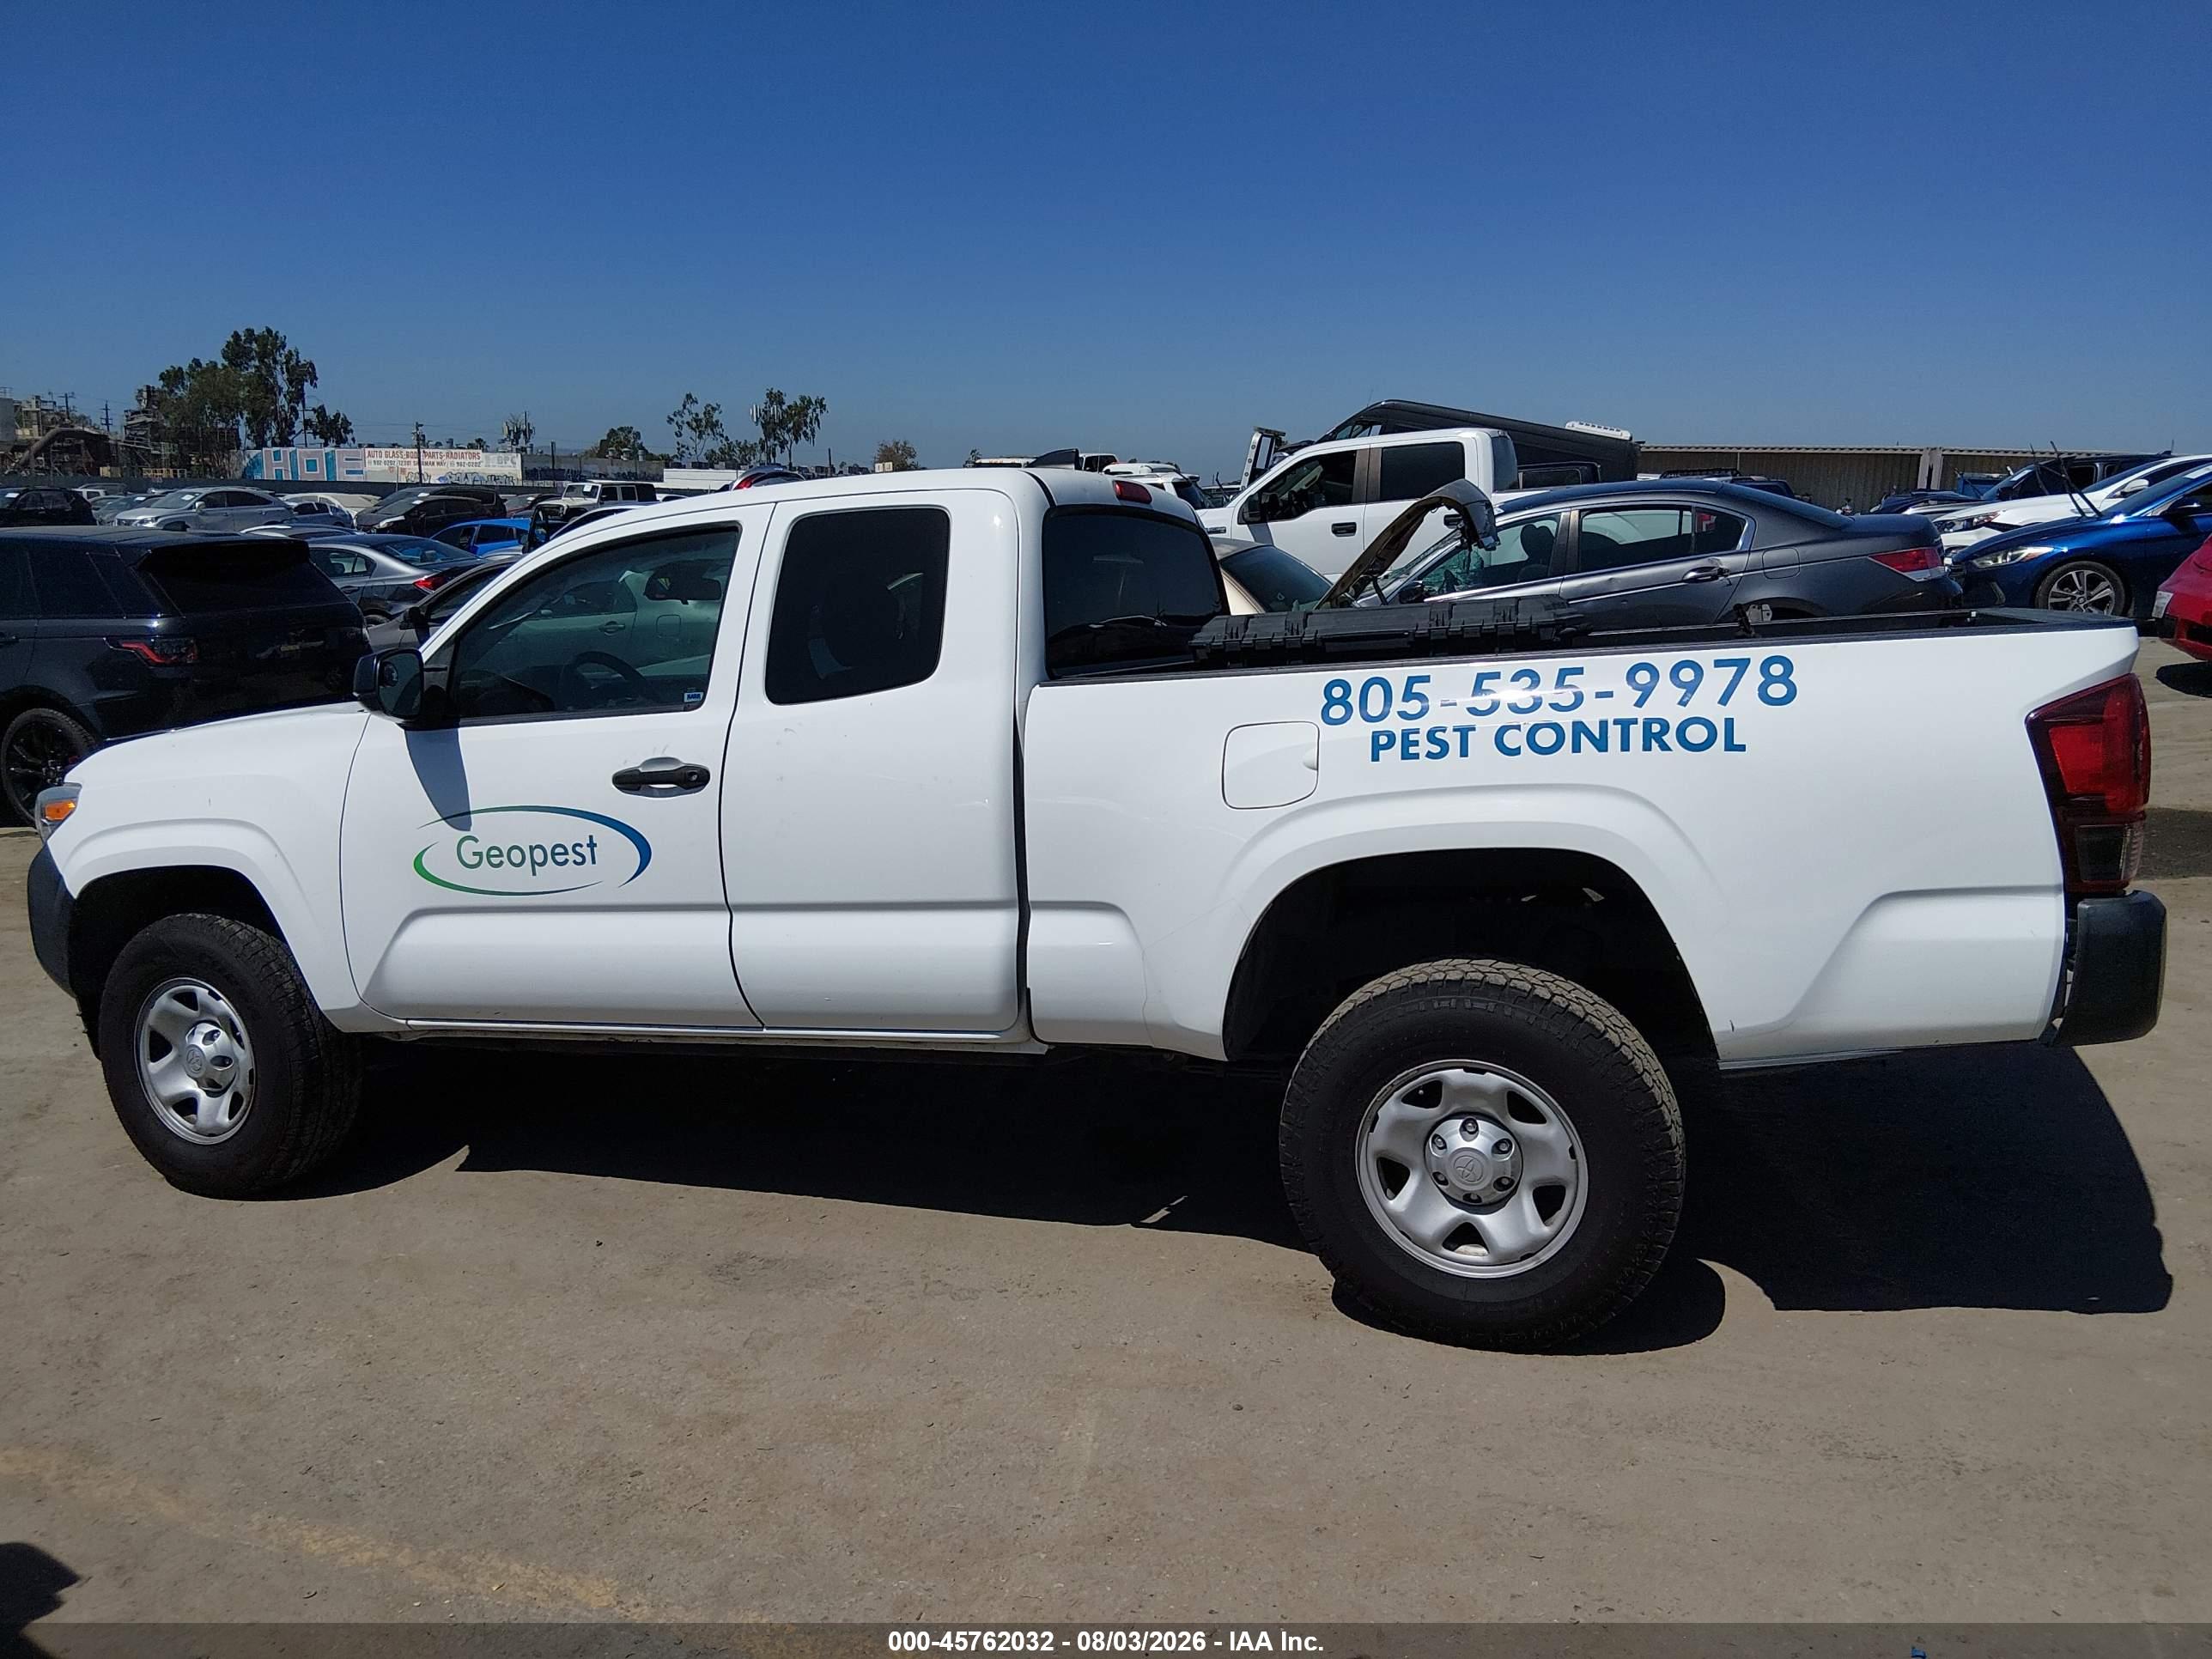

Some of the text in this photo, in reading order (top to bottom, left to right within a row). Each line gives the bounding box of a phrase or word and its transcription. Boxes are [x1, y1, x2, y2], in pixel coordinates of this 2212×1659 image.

[367, 449, 383, 459] AUTO
[1321, 655, 1798, 726] 805-535-9978
[1370, 716, 1747, 763] PEST CONTROL
[456, 835, 598, 876] Geopest
